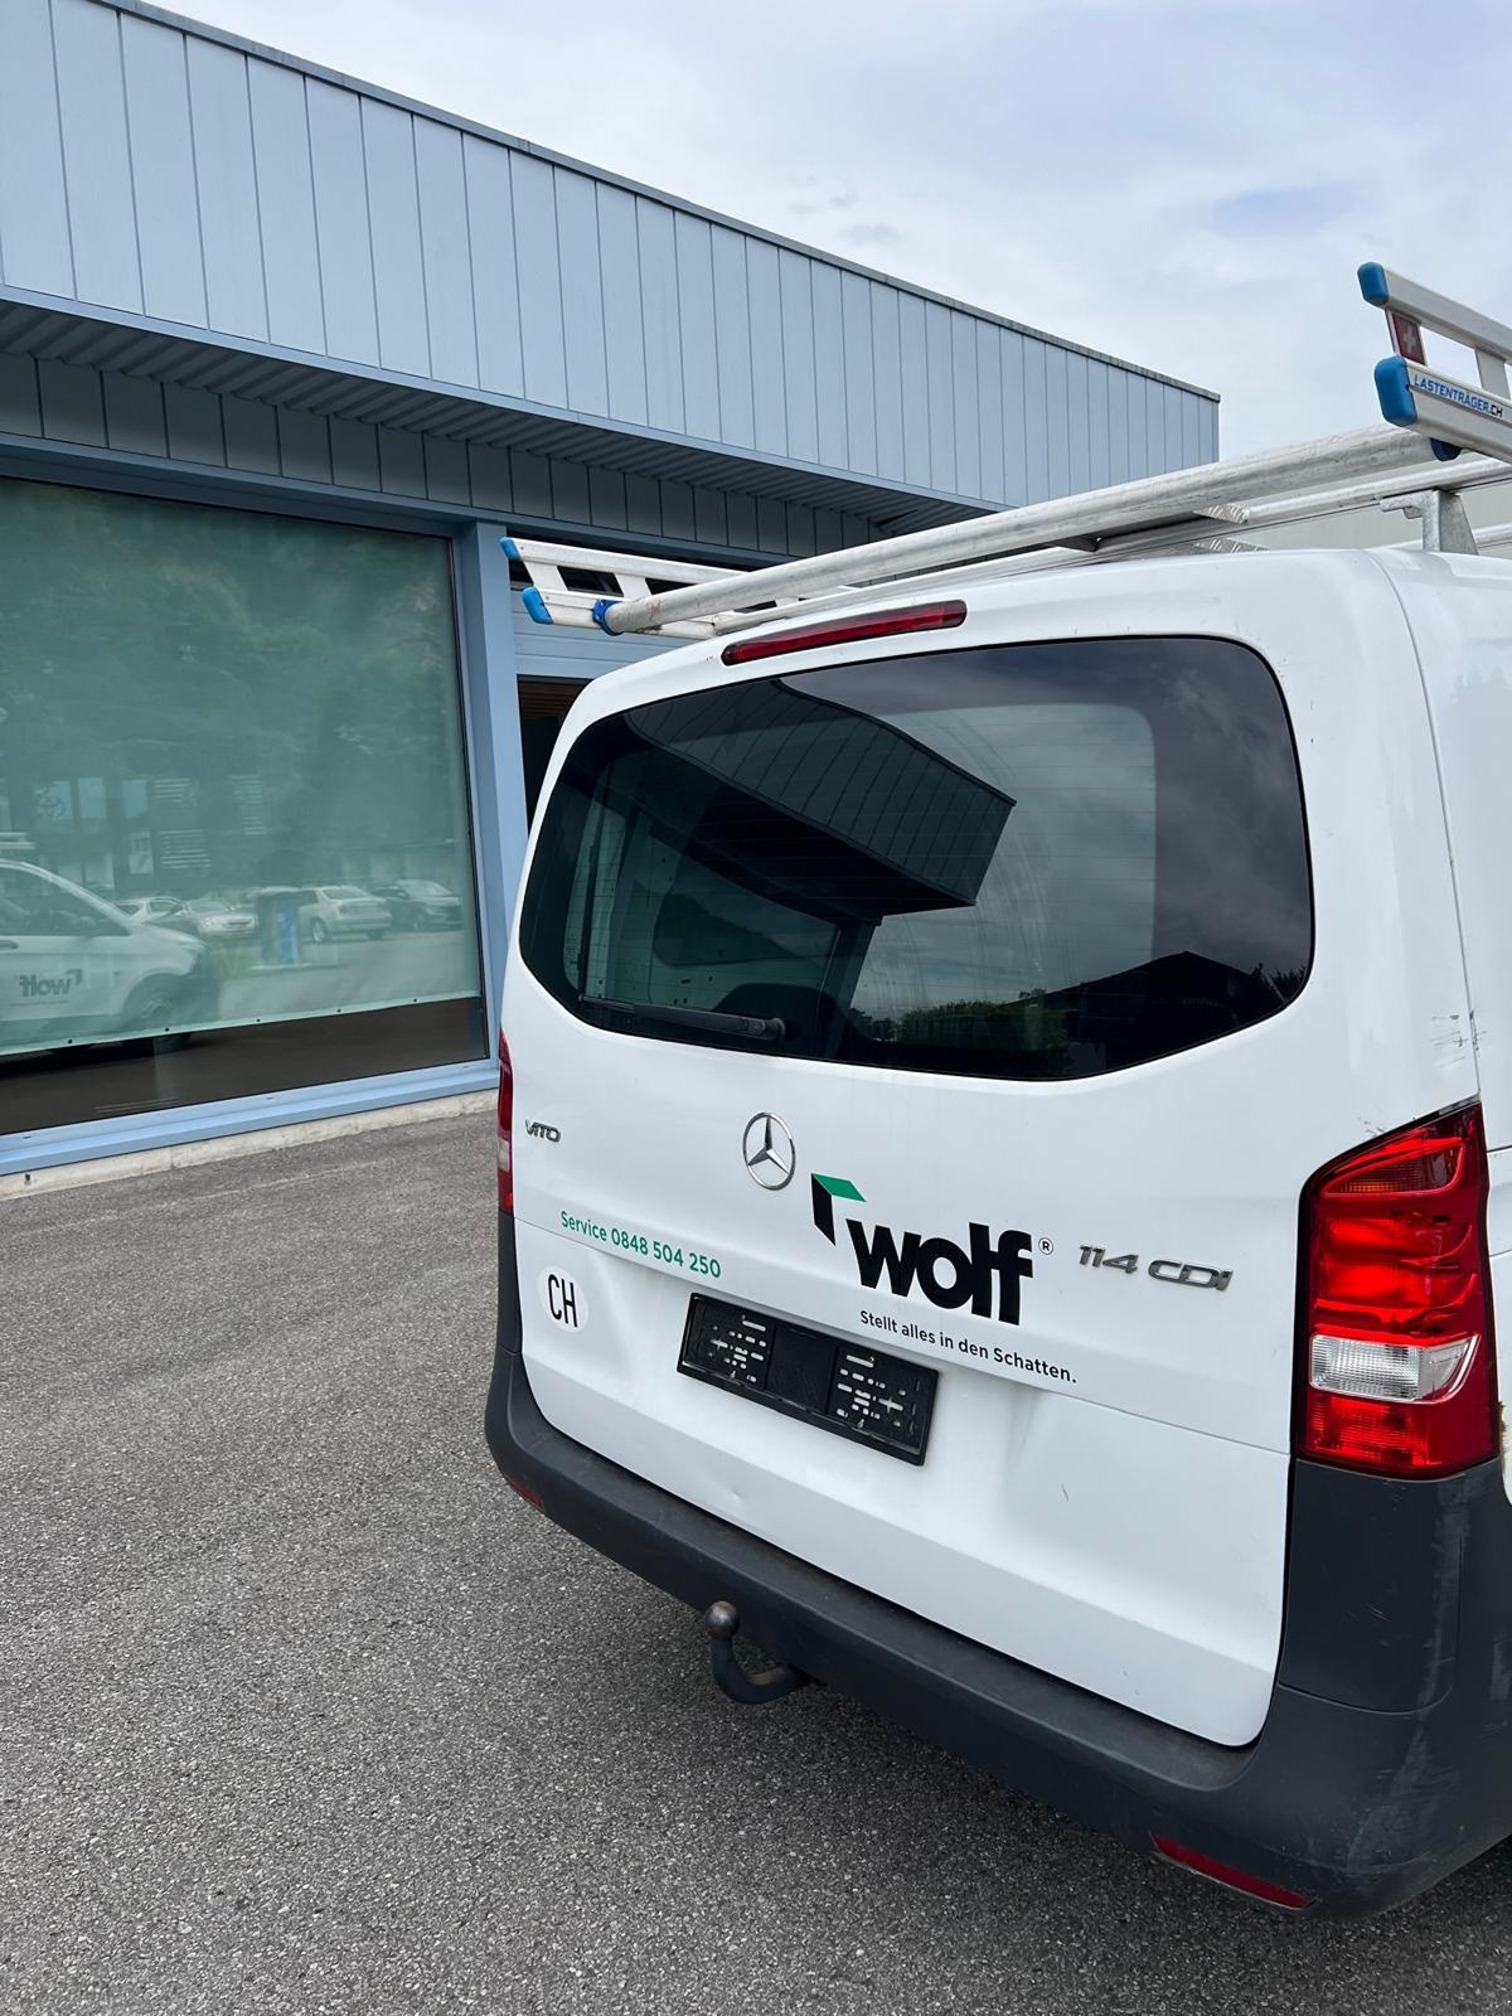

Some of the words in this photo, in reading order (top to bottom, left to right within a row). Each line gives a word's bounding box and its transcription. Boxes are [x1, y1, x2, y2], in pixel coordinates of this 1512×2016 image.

[525, 1119, 562, 1143] VITO
[561, 1211, 607, 1242] Service
[611, 1228, 648, 1257] 0848
[653, 1243, 684, 1268] 504
[689, 1252, 721, 1278] 250
[846, 1218, 1034, 1325] wolf
[1079, 1245, 1139, 1275] 114
[1148, 1259, 1233, 1292] CDI
[547, 1273, 578, 1328] CH
[860, 1310, 898, 1333] Stellt
[901, 1323, 936, 1344] alles
[939, 1331, 954, 1348] in
[958, 1339, 989, 1358] den
[993, 1347, 1077, 1383] Schatten.
